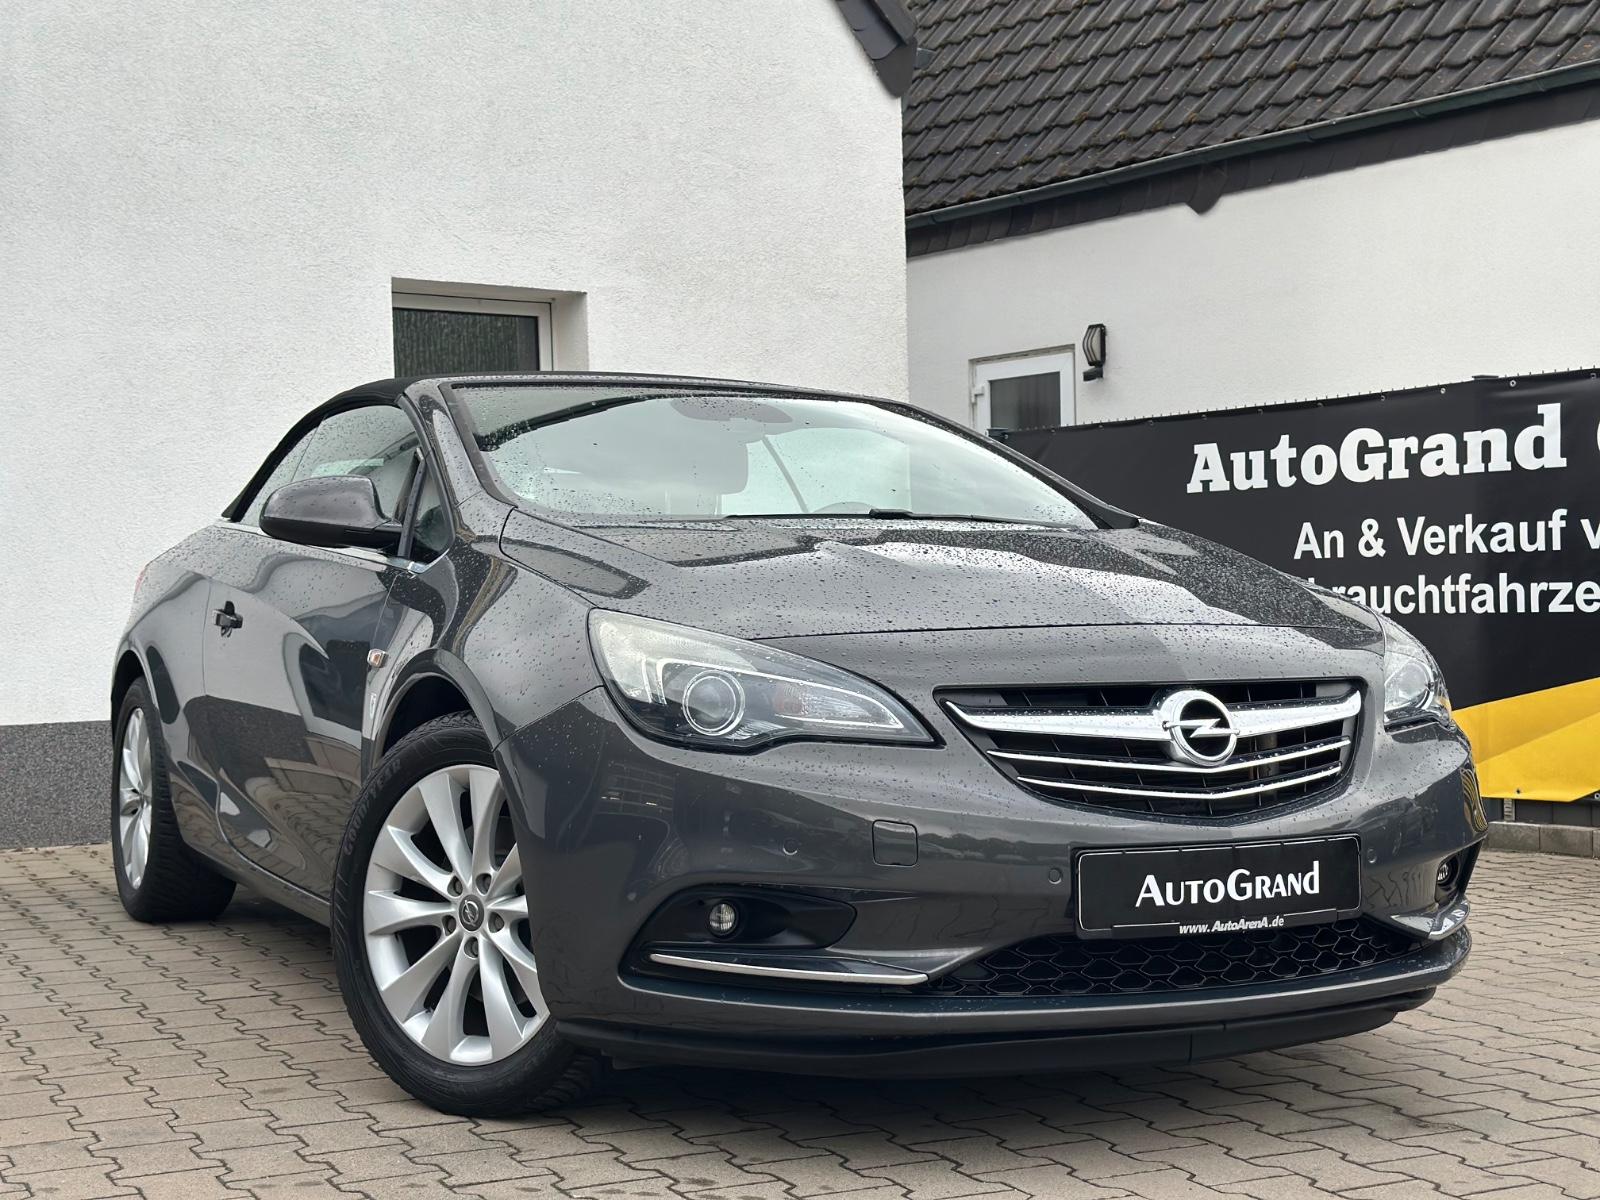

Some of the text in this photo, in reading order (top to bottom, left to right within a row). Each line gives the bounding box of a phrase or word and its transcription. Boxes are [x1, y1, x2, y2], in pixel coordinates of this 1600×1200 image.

[1187, 403, 1567, 493] AutoGrand
[1294, 522, 1344, 559] An
[1358, 518, 1386, 557] &
[1397, 509, 1567, 555] Verkauf
